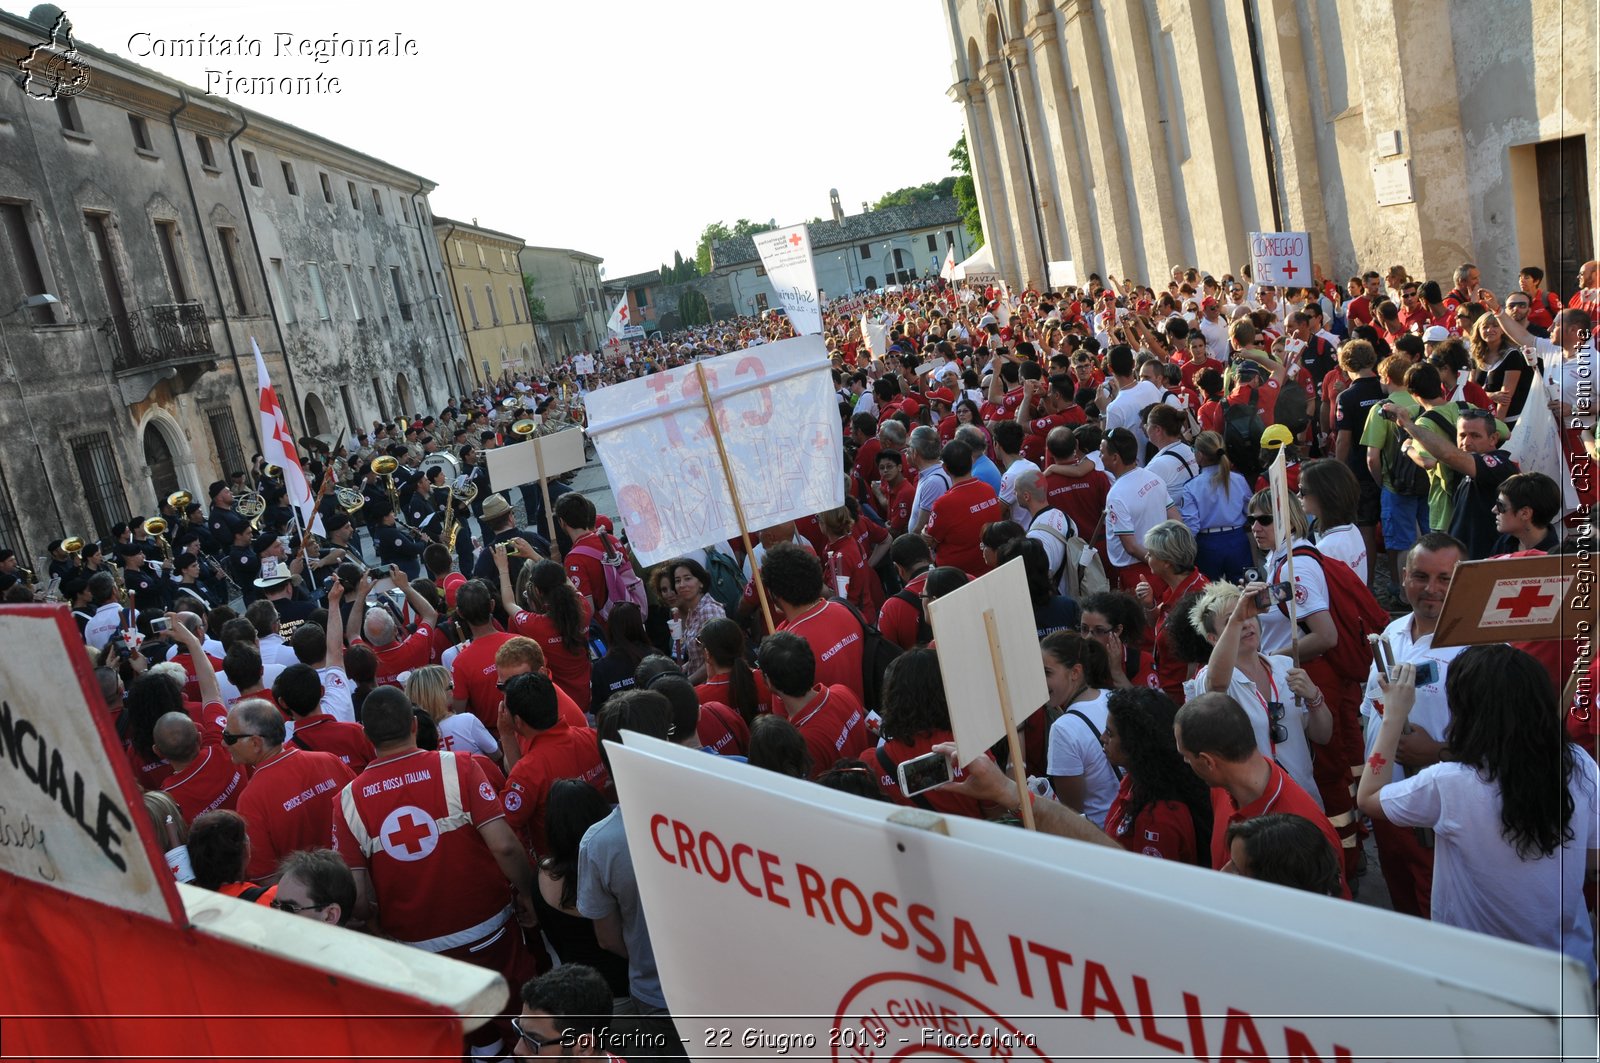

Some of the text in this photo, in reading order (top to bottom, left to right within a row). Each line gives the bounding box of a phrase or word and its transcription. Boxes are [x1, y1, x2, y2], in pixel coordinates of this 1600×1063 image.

[1253, 237, 1304, 257] CORREGGIO
[968, 275, 997, 283] PAVIA
[1257, 262, 1273, 282] RE
[838, 301, 862, 315] BIELLA
[362, 769, 432, 798] CROCE ROSSA ITALIANA
[283, 795, 302, 812] CROCE
[650, 813, 791, 909] CROCE
[795, 862, 999, 986] ROSSA
